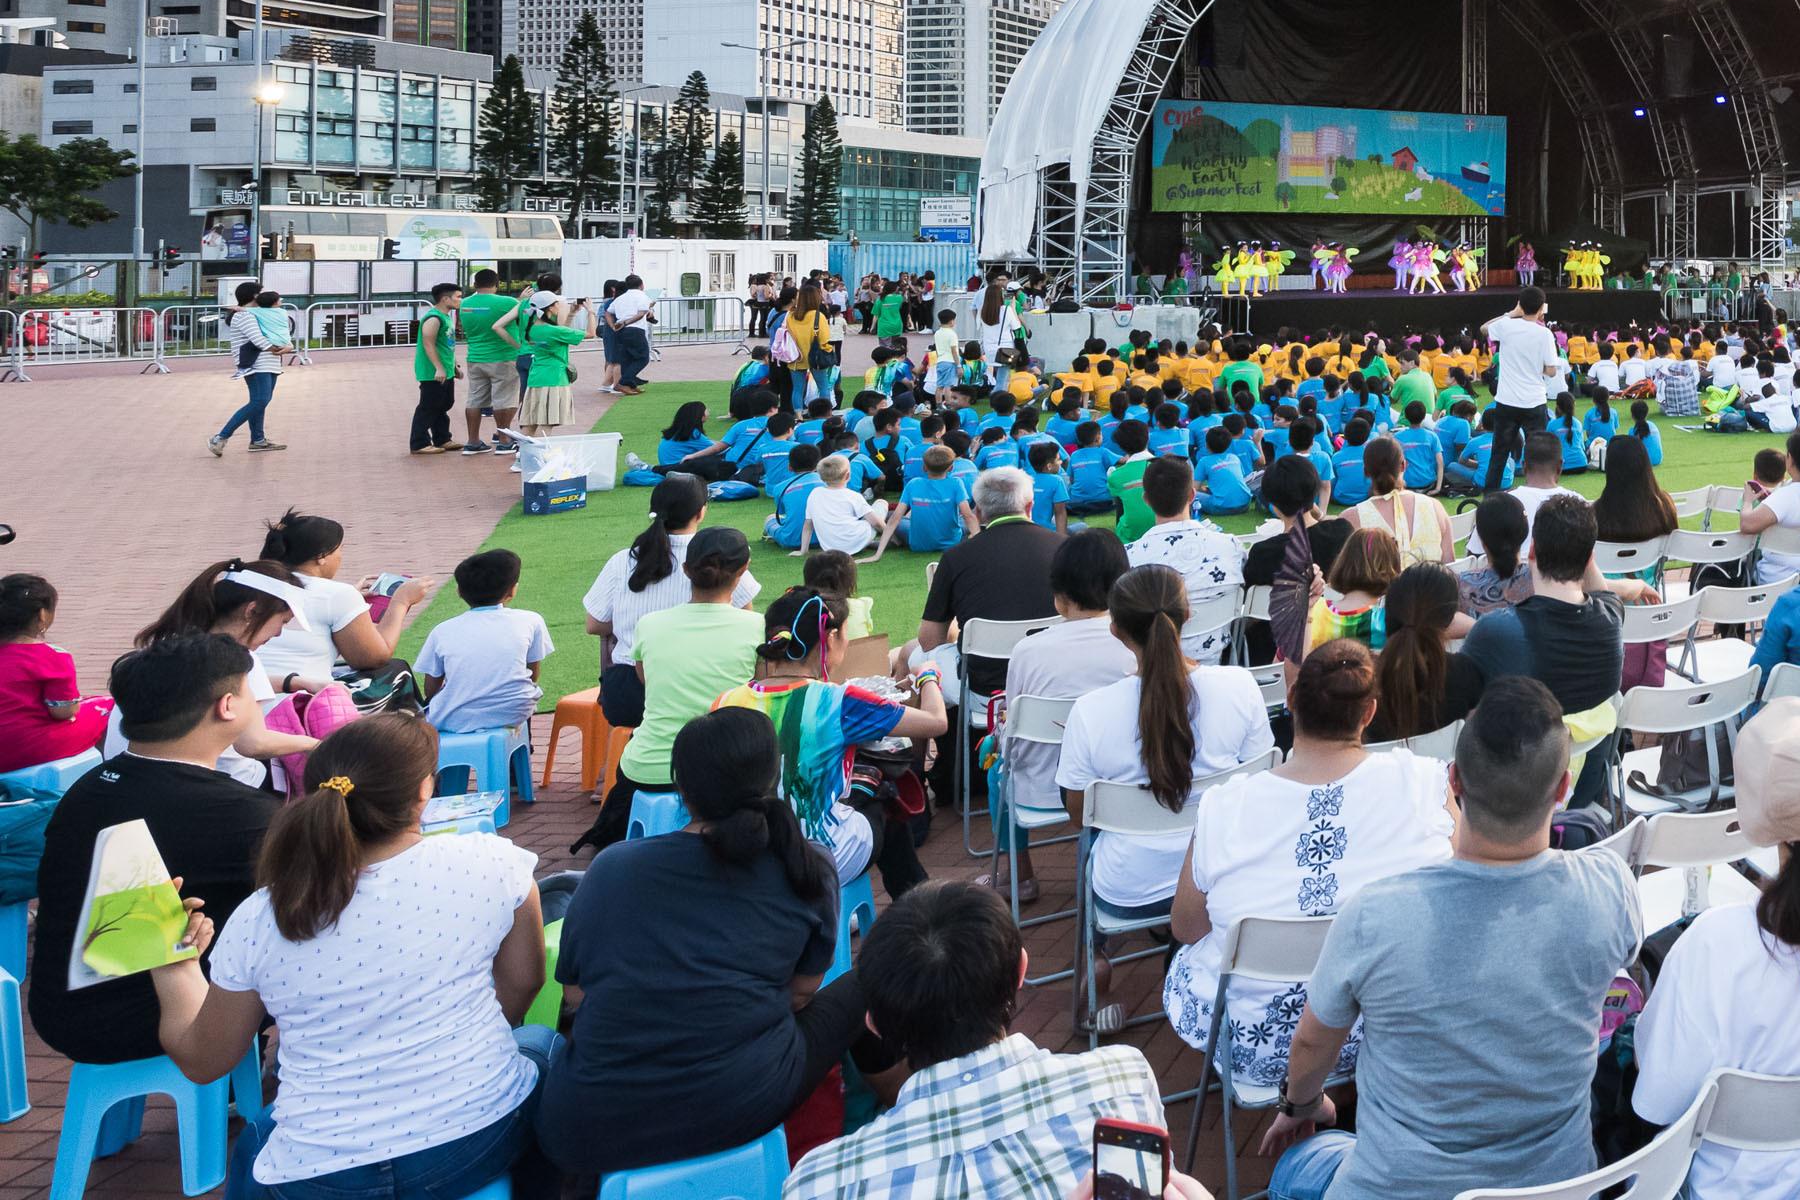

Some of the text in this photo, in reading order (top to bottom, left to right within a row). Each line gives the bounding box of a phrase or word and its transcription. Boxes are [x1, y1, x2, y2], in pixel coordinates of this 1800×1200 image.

[1192, 167, 1236, 184] Earth
[287, 190, 428, 208] CITY GALLERY
[525, 198, 559, 212] CITY
